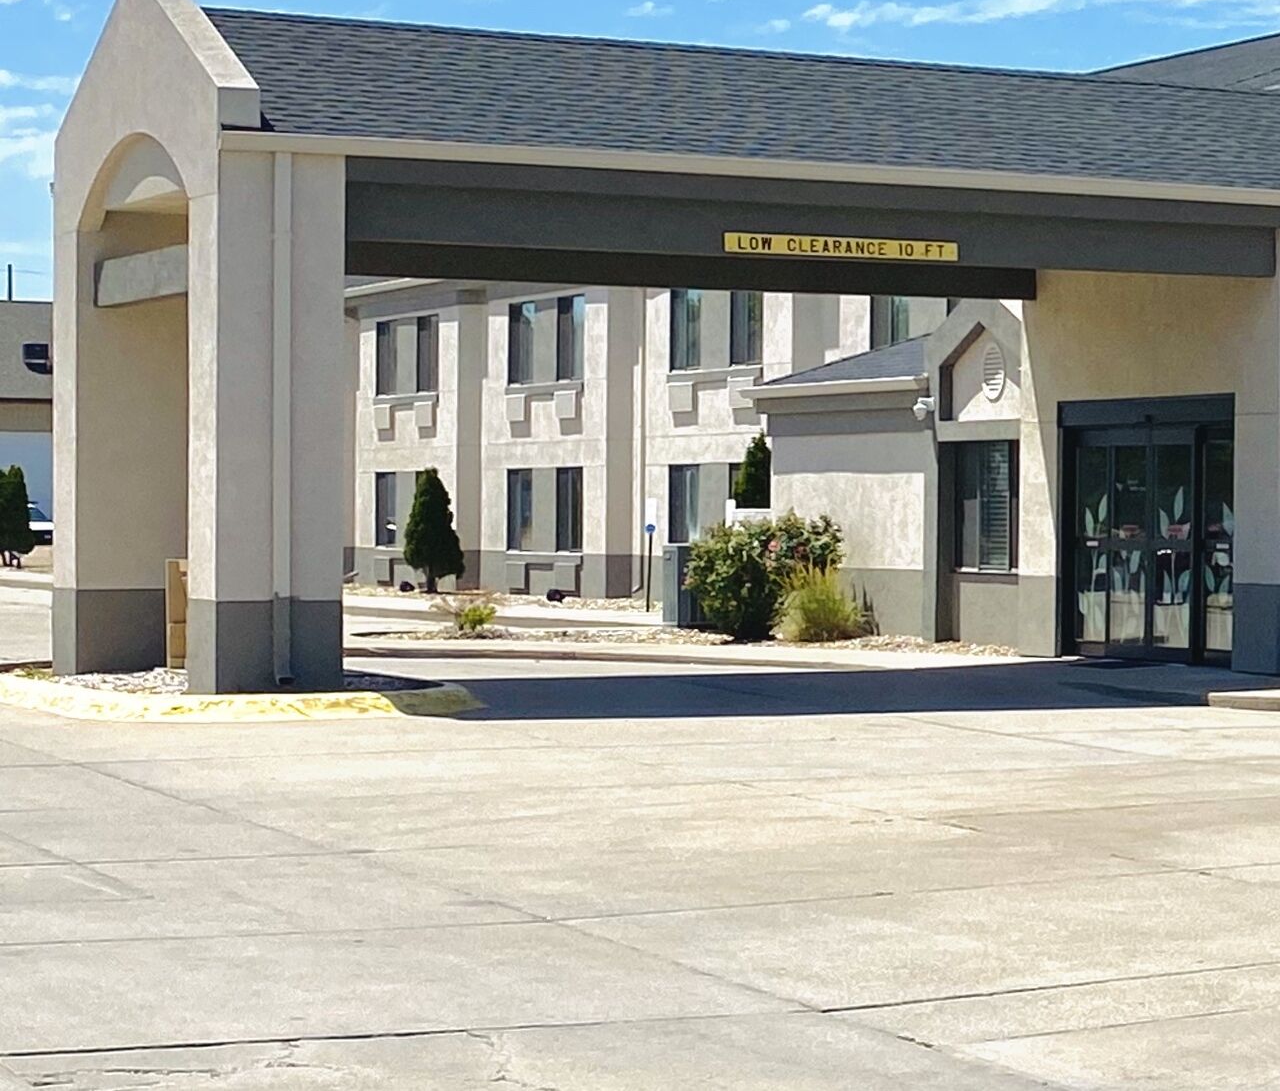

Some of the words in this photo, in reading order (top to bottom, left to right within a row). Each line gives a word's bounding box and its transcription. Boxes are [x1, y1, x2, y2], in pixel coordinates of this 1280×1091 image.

[737, 236, 772, 251] LOW
[787, 238, 887, 256] CLEARANCE
[899, 242, 914, 256] 10
[925, 244, 945, 258] FT
